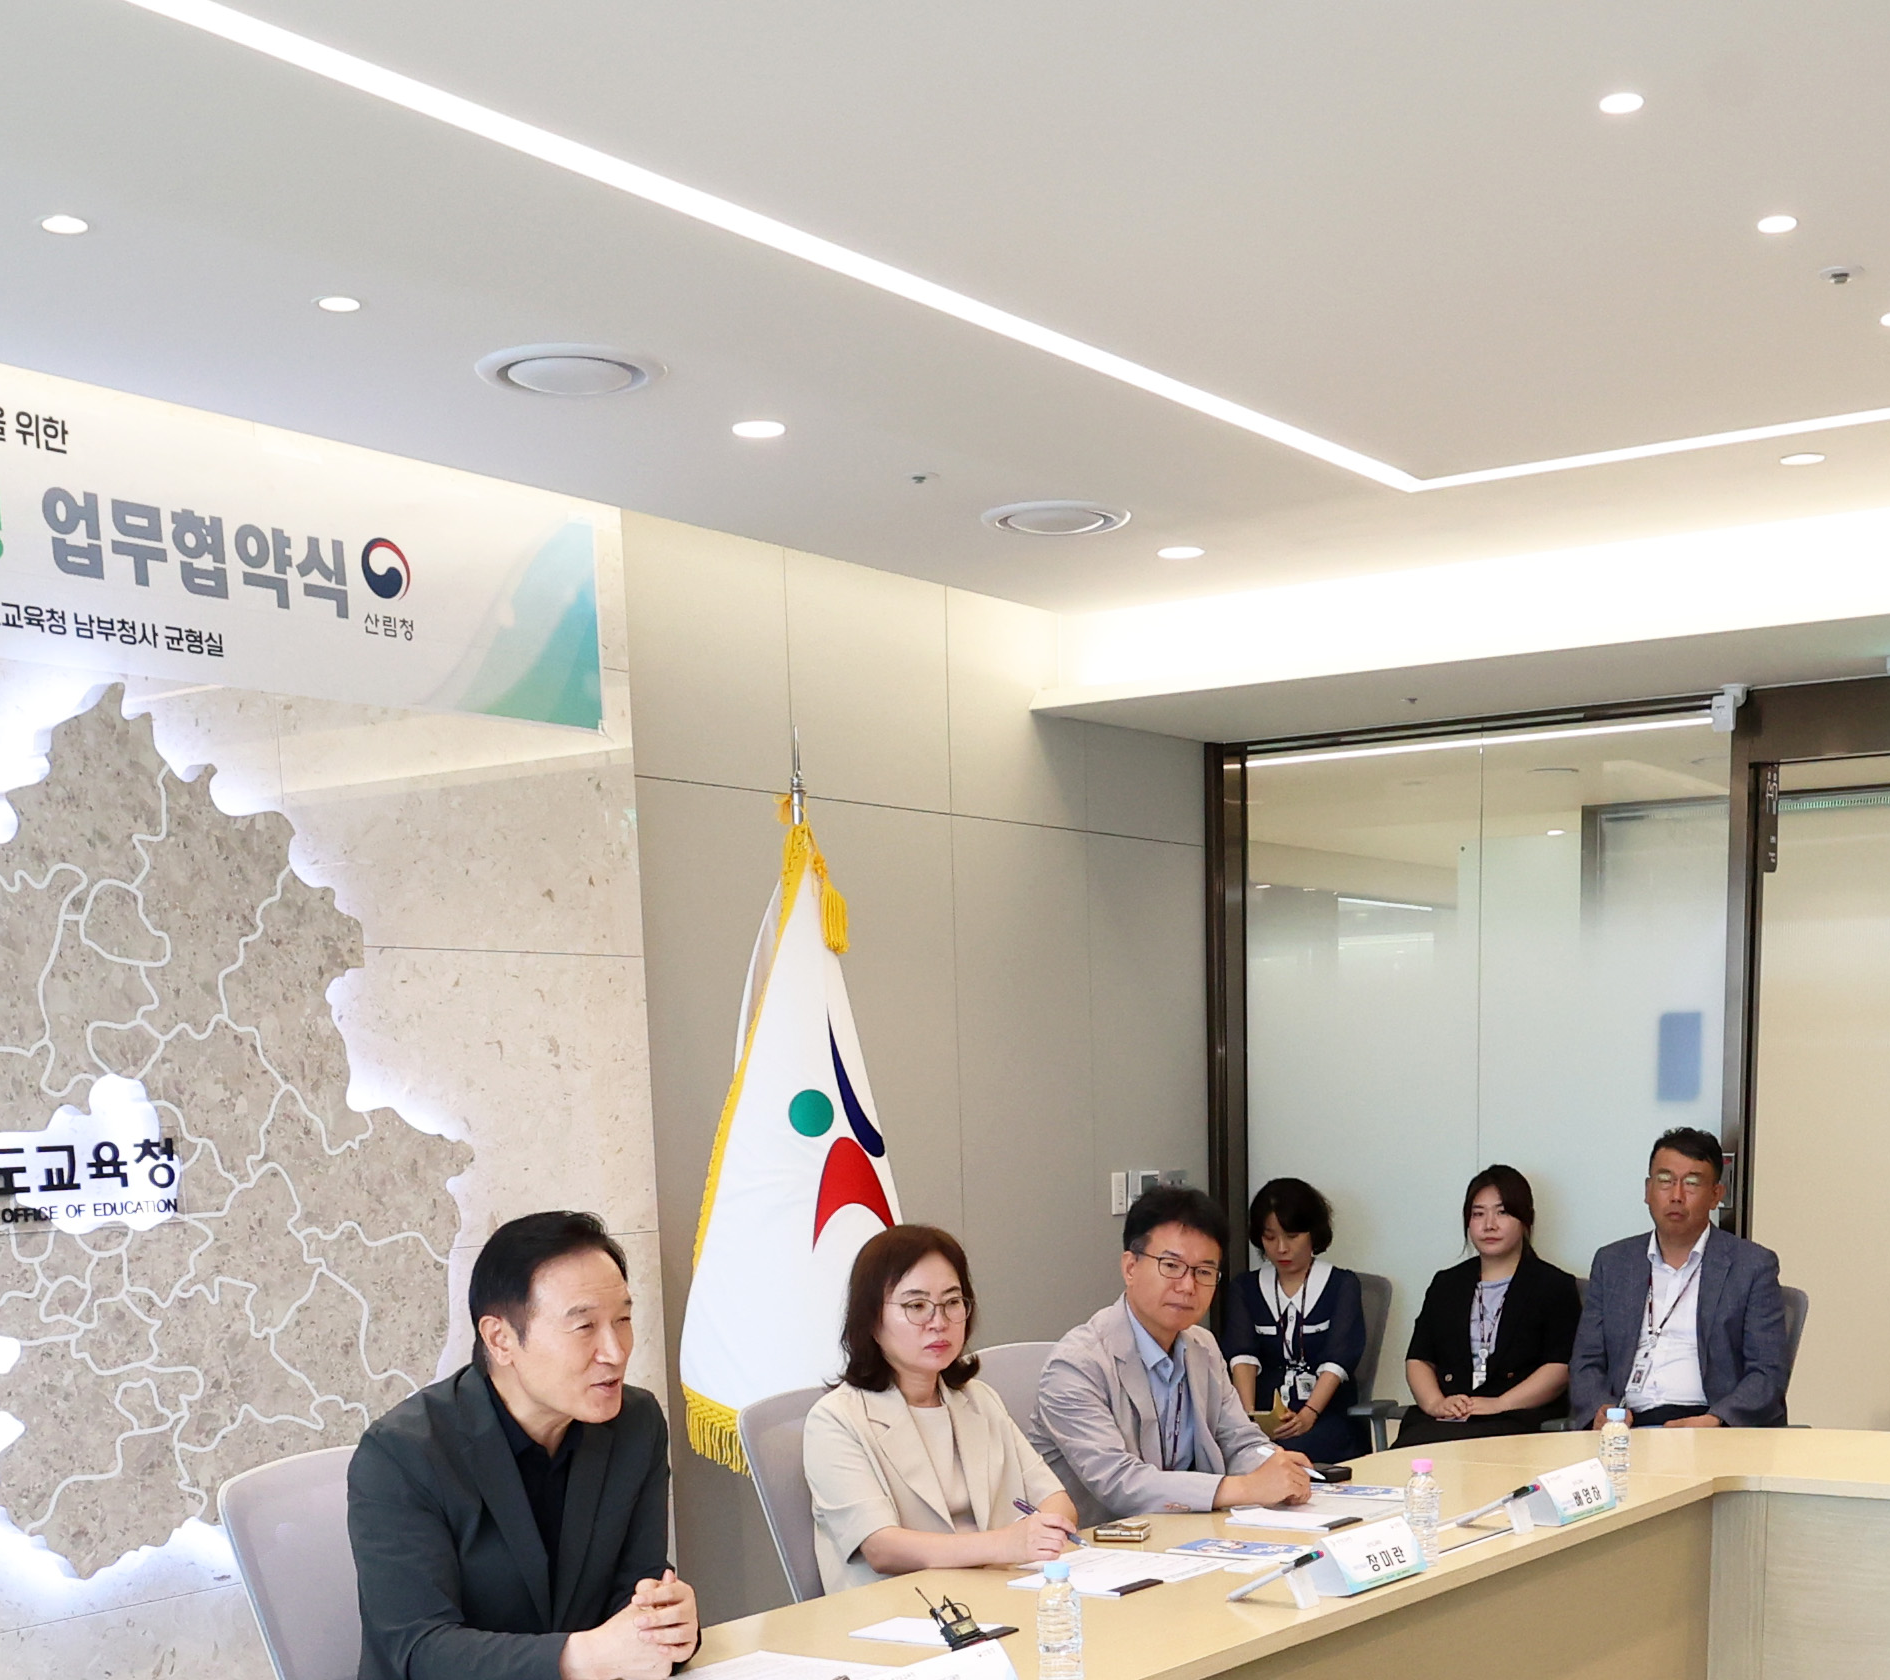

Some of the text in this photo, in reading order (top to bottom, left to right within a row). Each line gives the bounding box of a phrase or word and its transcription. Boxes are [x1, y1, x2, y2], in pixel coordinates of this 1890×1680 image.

[15, 411, 69, 455] 위한
[41, 485, 351, 620] 업무협약식
[74, 611, 159, 649] 남부청사
[164, 625, 226, 658] 균형실
[362, 611, 416, 643] 산림청
[1, 1204, 59, 1225] OFFICE
[65, 1203, 87, 1219] OF
[93, 1198, 179, 1218] EDUCATION
